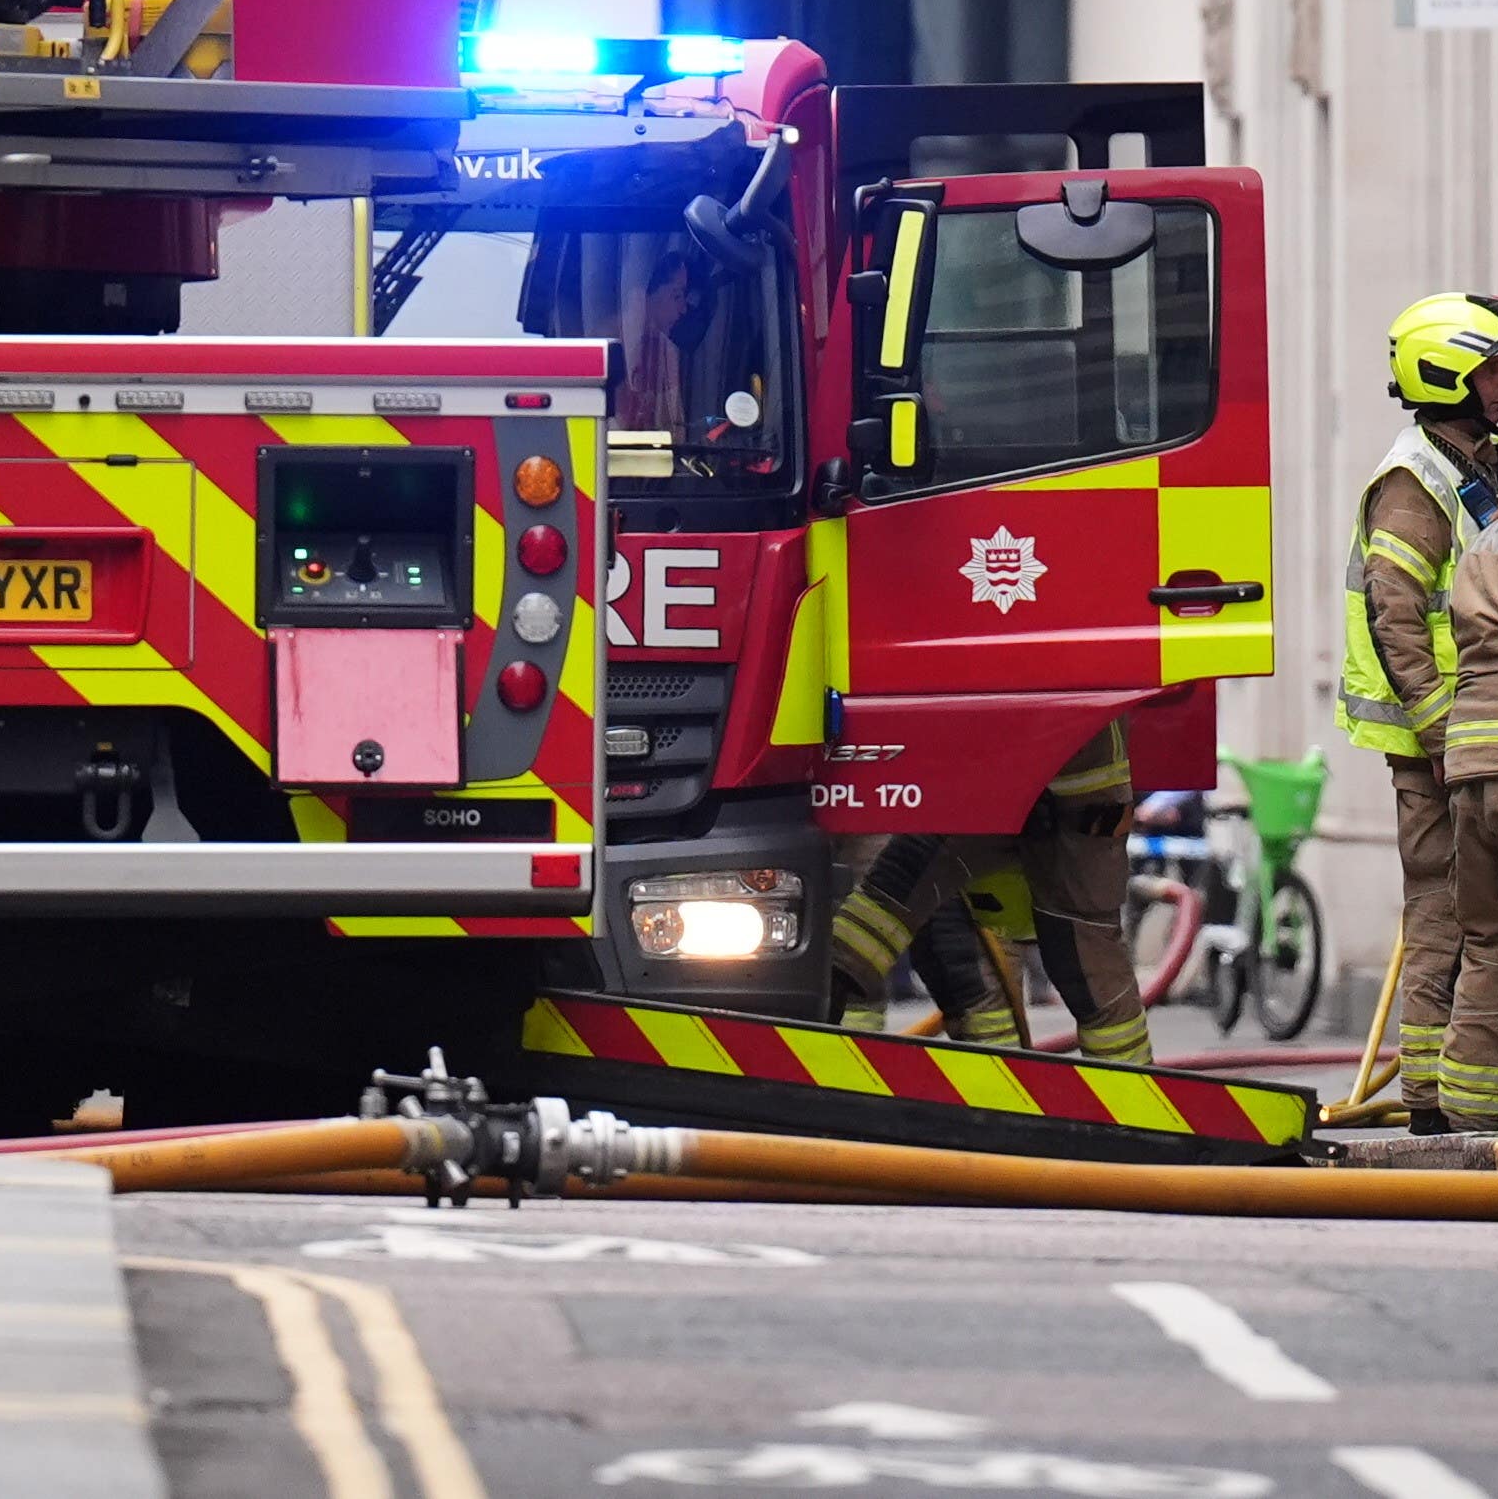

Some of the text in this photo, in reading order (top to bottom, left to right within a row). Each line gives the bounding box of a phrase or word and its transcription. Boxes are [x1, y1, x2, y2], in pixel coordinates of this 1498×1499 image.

[810, 783, 923, 808] DPL 170
[423, 809, 482, 827] SOHO
